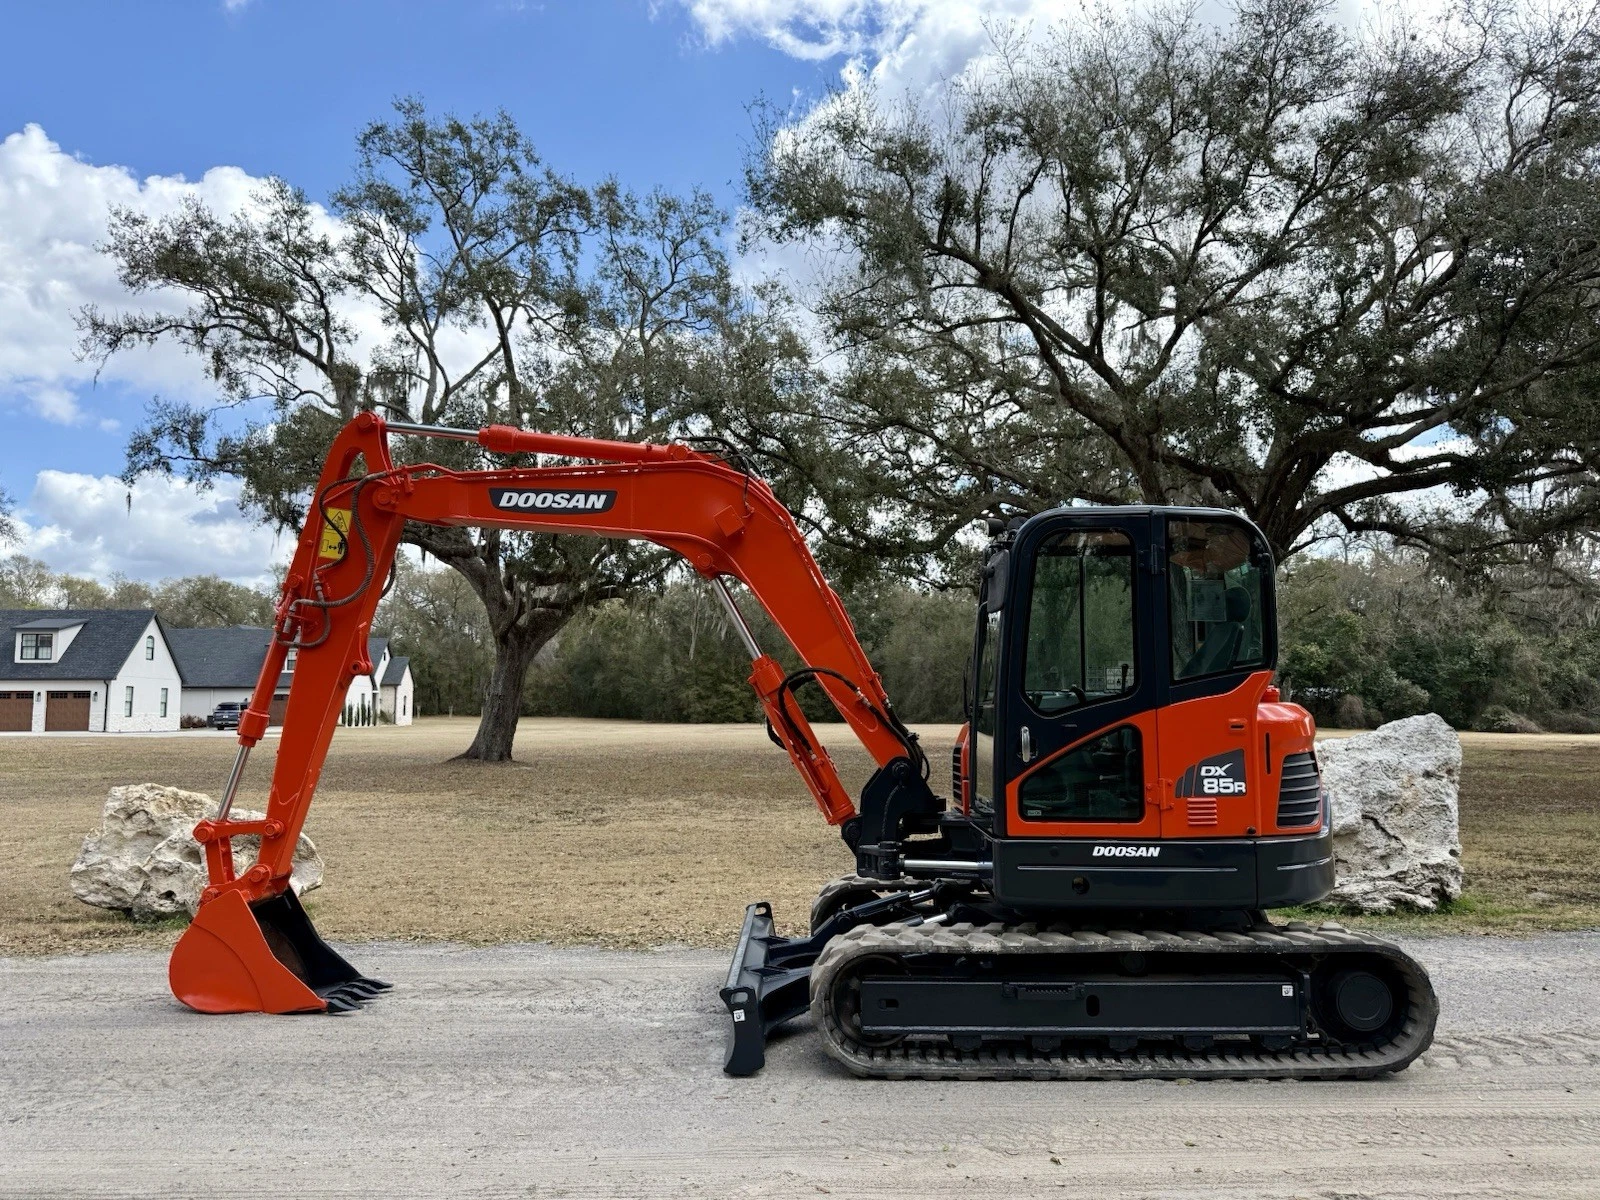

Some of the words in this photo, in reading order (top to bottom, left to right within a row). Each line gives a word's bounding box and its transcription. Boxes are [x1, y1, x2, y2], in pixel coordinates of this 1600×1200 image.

[499, 491, 607, 509] DOOSAN
[1200, 762, 1233, 777] DX
[1203, 778, 1247, 794] 85R
[1092, 845, 1160, 857] DOOSAN
